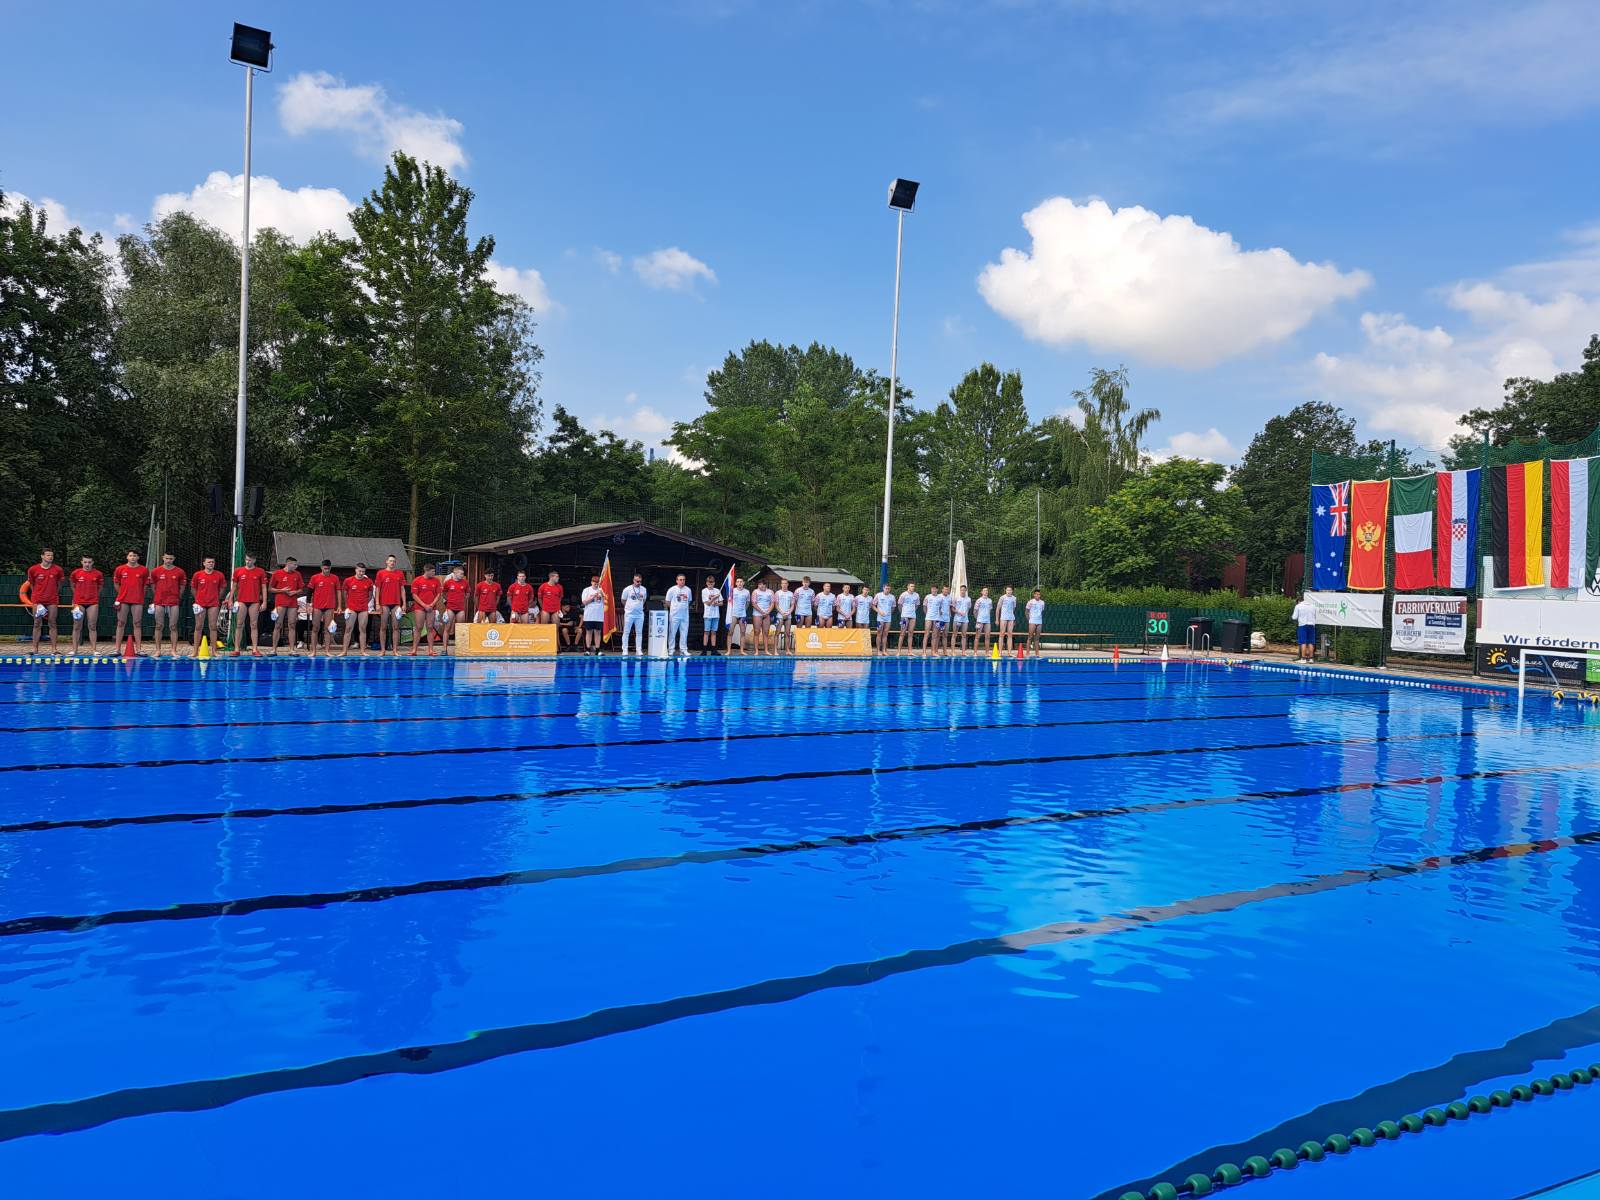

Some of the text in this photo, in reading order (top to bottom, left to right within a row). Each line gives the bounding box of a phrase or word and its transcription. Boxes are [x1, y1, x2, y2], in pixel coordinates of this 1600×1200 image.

[1397, 601, 1461, 614] FABRIKVERKAUF
[1148, 619, 1168, 634] 30
[1503, 634, 1600, 649] Wir fördern
